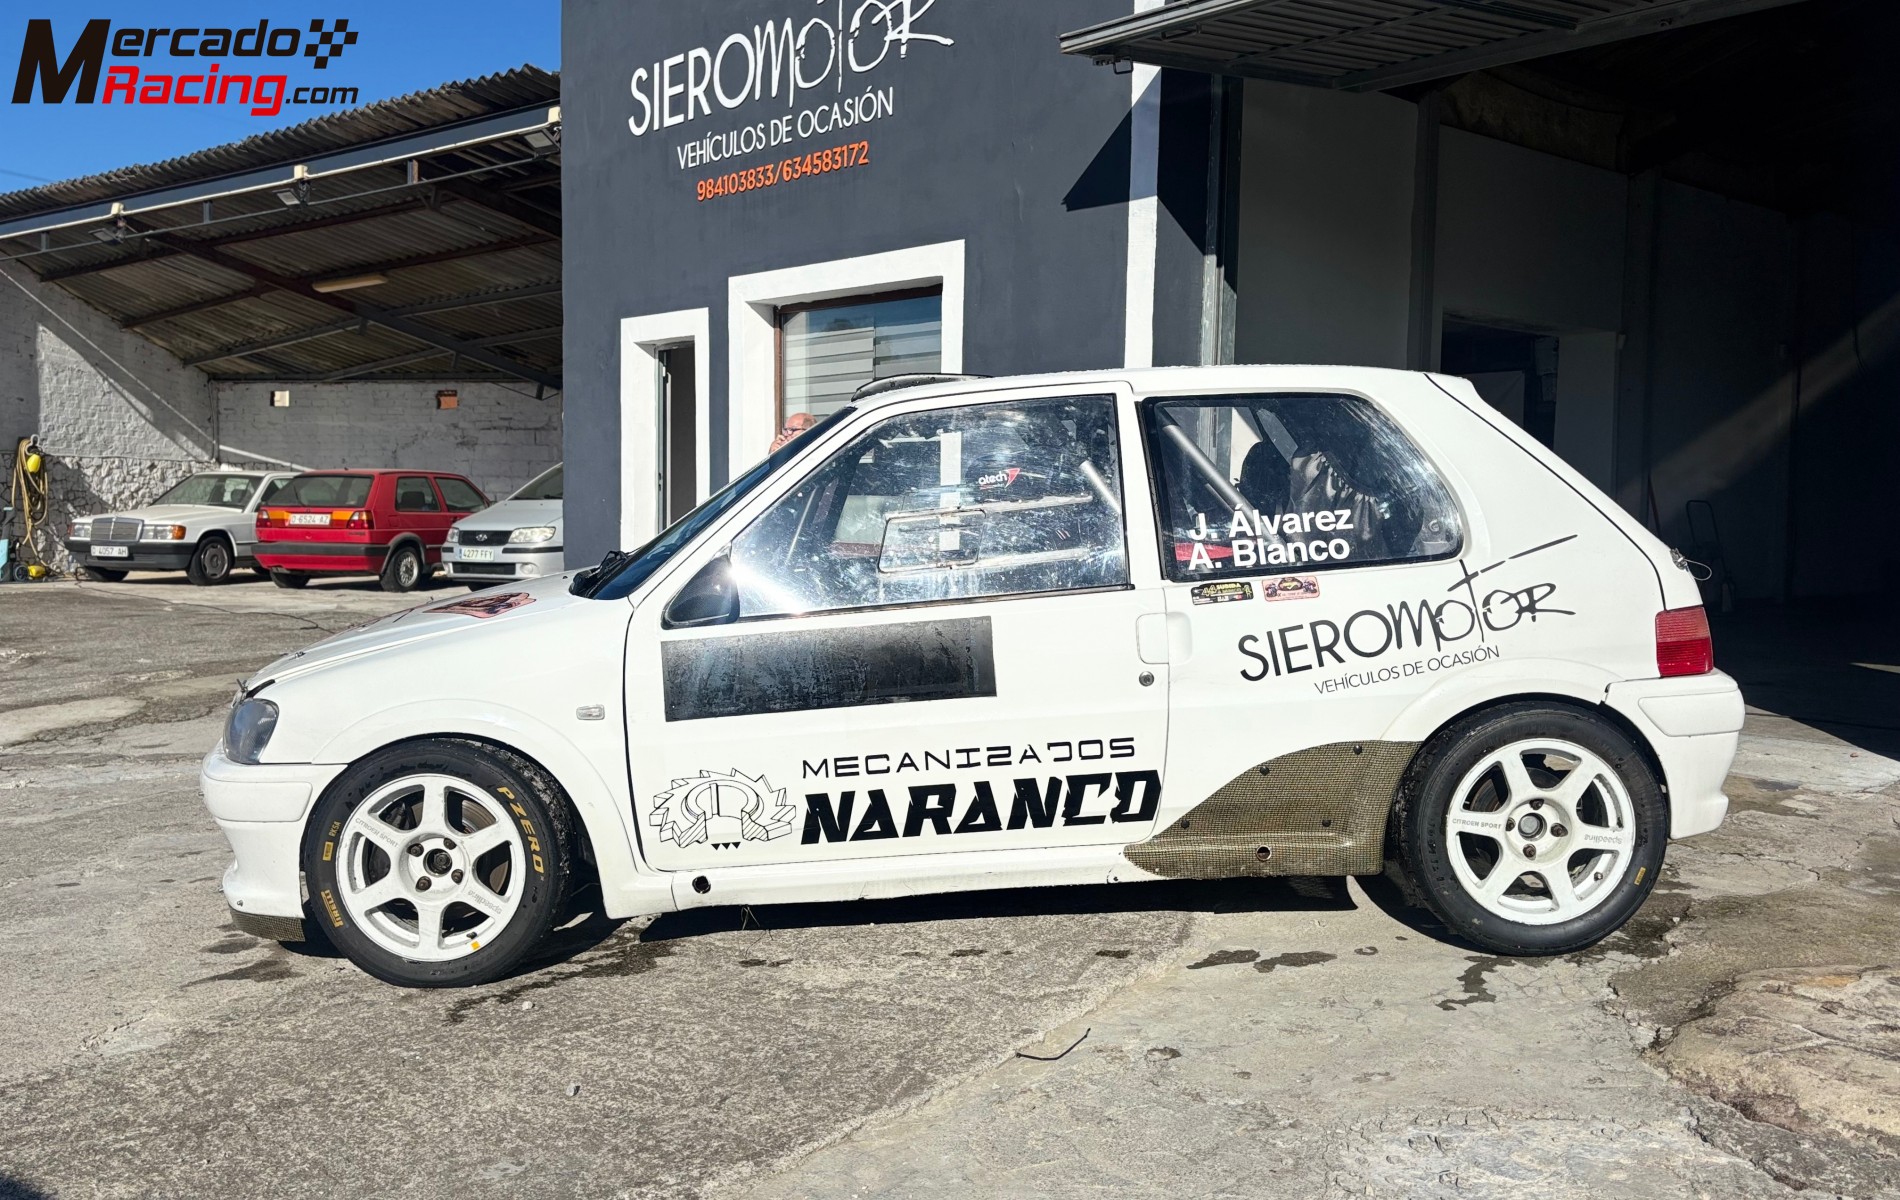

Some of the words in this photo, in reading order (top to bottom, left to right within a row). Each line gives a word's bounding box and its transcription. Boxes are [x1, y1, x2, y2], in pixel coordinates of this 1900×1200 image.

[677, 123, 766, 169] VEHÍCULOS
[770, 115, 793, 147] DE
[797, 86, 894, 138] OCASIÓN
[697, 140, 870, 201] 984103833/634583172
[1189, 512, 1218, 541] J.
[1228, 504, 1354, 539] Álvarez
[463, 549, 479, 558] 4277
[1188, 542, 1223, 571] A.
[1231, 538, 1351, 567] Blanco
[1237, 534, 1578, 683] SIEROMOTOR
[1314, 665, 1401, 694] VEHÍCULOS
[1402, 660, 1425, 677] DE
[1427, 645, 1501, 671] OCASIÓN
[800, 769, 1161, 845] NARANCO
[1480, 820, 1502, 830] SPORT
